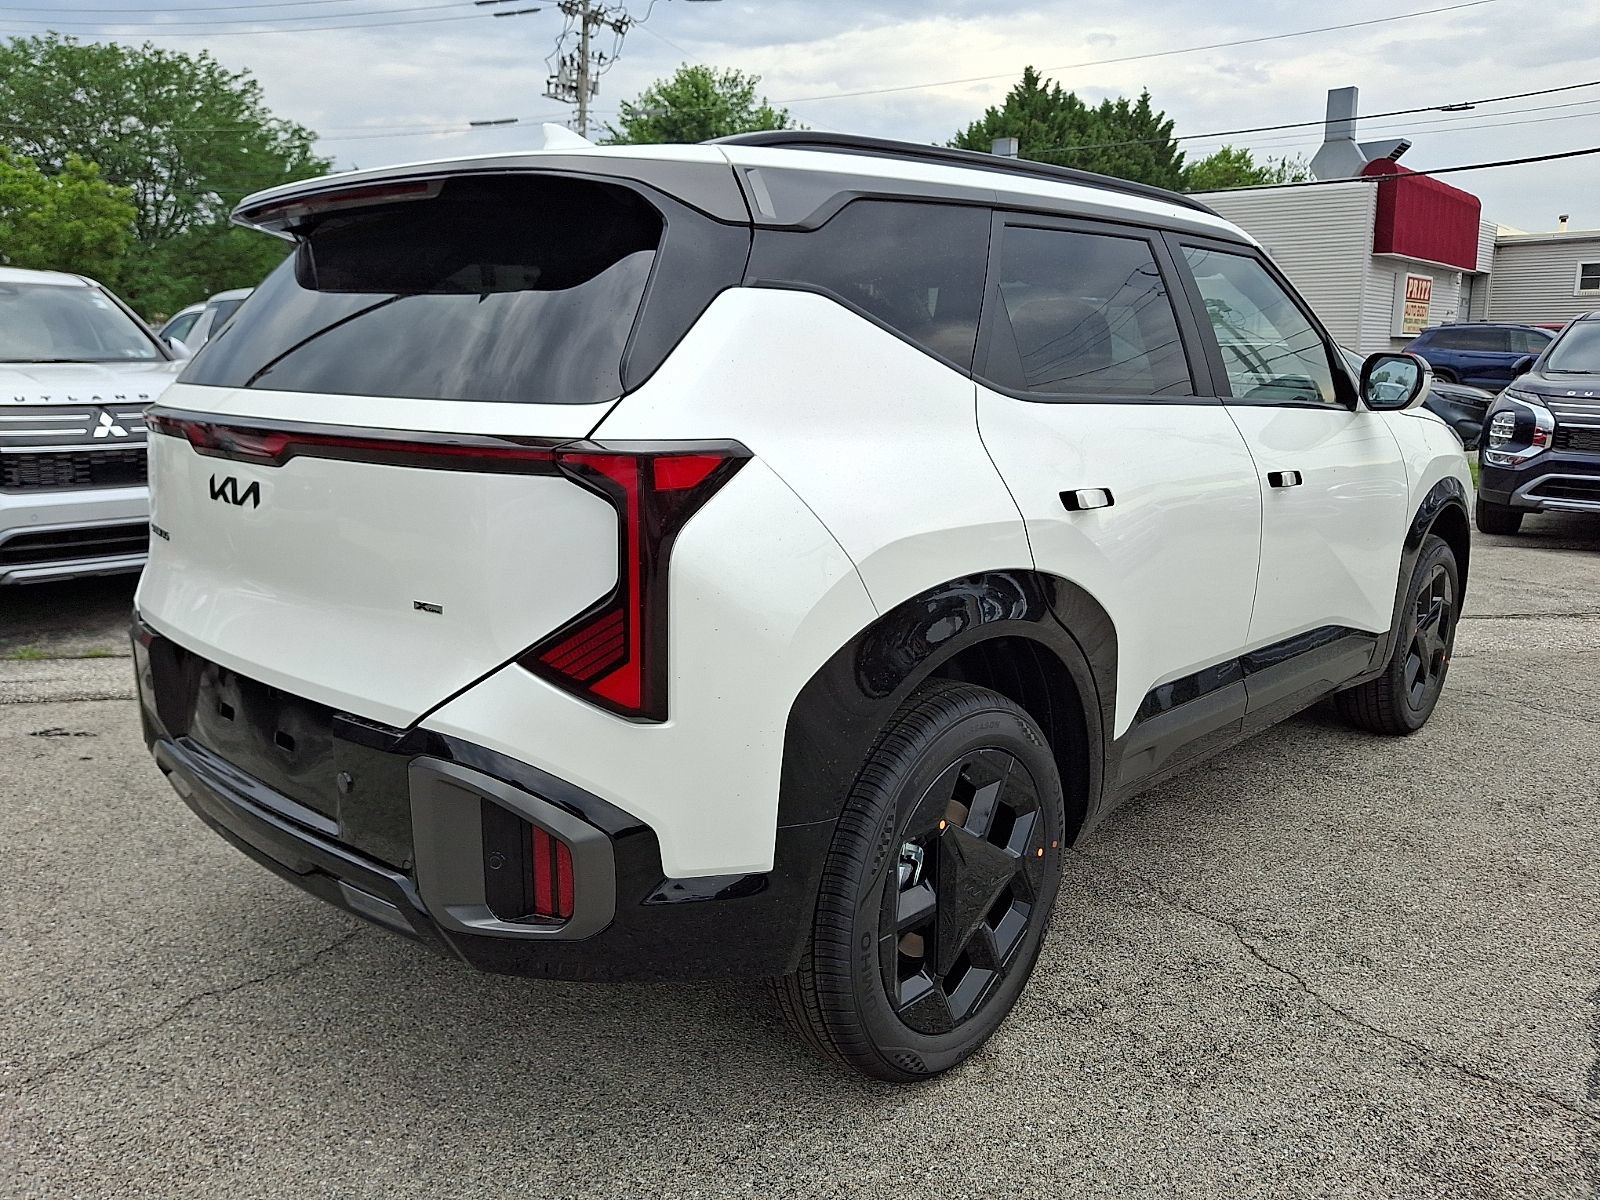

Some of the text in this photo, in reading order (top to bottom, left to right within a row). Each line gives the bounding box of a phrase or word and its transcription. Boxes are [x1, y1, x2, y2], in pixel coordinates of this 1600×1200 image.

[1407, 278, 1431, 300] PRITZ
[209, 473, 261, 509] KIA
[860, 931, 878, 1013] UMHO
